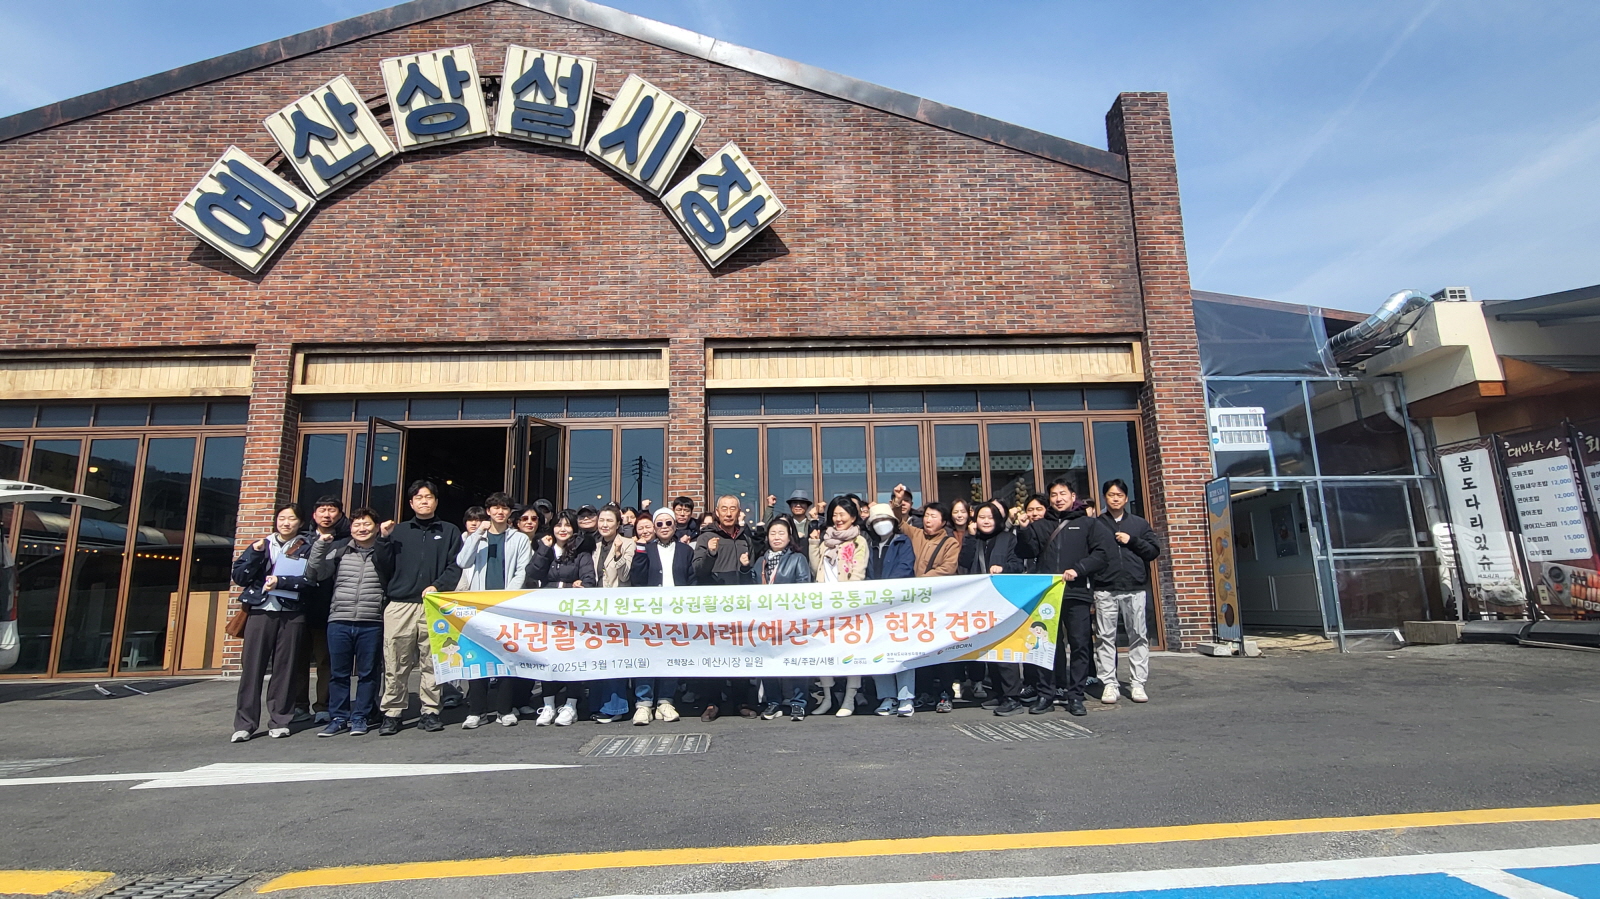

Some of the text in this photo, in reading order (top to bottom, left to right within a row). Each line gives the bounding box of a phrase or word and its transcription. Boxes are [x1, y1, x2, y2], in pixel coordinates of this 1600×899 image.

[195, 55, 767, 248] 예산상설시장
[1507, 437, 1562, 457] 대박수산
[1548, 464, 1568, 472] 10,000
[1551, 478, 1572, 486] 12,000
[1554, 492, 1575, 500] 12,000
[1557, 505, 1578, 513] 12,000
[1560, 519, 1581, 527] 15,000
[1564, 533, 1585, 541] 15,000
[559, 586, 933, 616] 여주시 원도심 상권활성화 외식산업 공통교육 과정
[495, 620, 631, 653] 상권활성화
[639, 612, 874, 649] 선진사례(예산시장)
[884, 611, 937, 643] 현장
[551, 660, 587, 673] 2025년
[591, 660, 607, 671] 3월
[611, 657, 650, 670] 17일(월)
[666, 658, 695, 667] 견학장소
[701, 657, 741, 668] 예산시장
[744, 655, 764, 667] 일원
[782, 656, 835, 668] 주최/주관/시행
